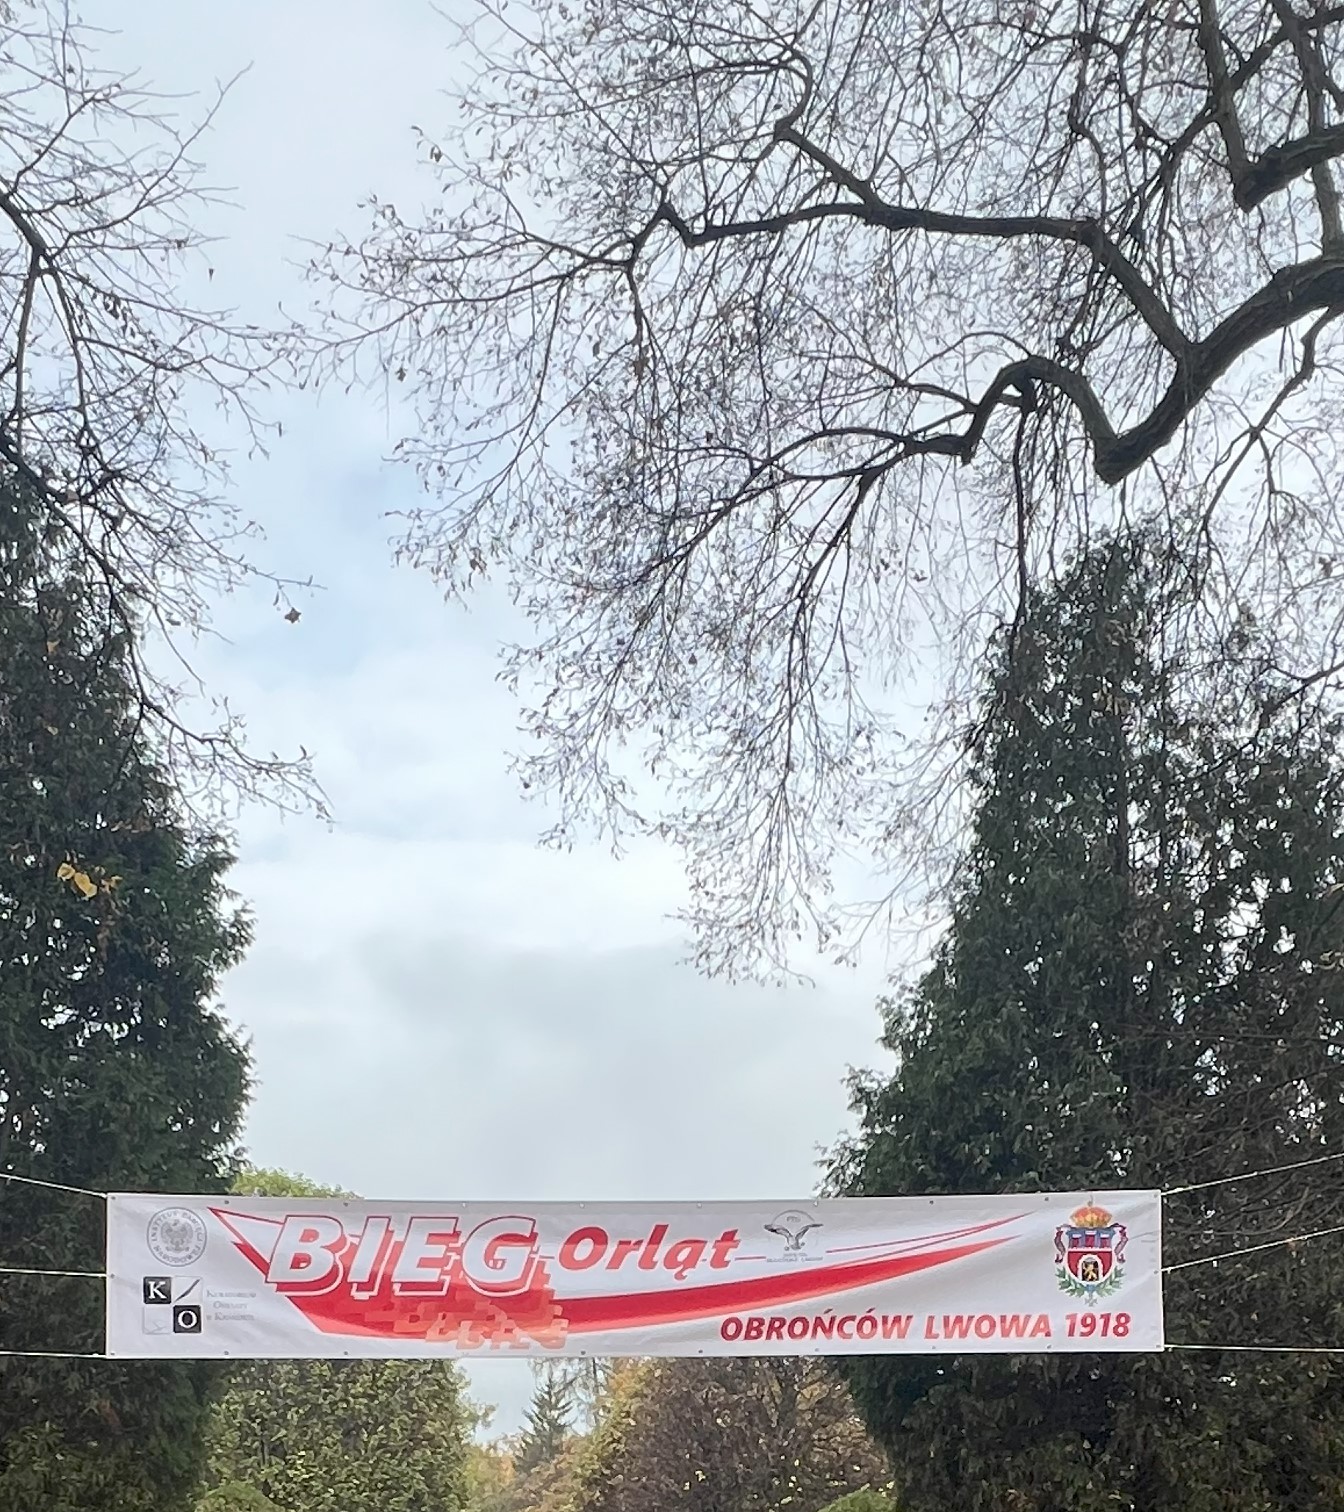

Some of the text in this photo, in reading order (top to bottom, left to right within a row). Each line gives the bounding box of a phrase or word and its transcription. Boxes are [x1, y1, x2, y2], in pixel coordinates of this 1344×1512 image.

[265, 1213, 740, 1294] BIEG Orląt
[148, 1280, 167, 1300] K
[177, 1310, 198, 1329] O
[719, 1308, 1131, 1342] OBROŃCÓW LWOWA 1918
